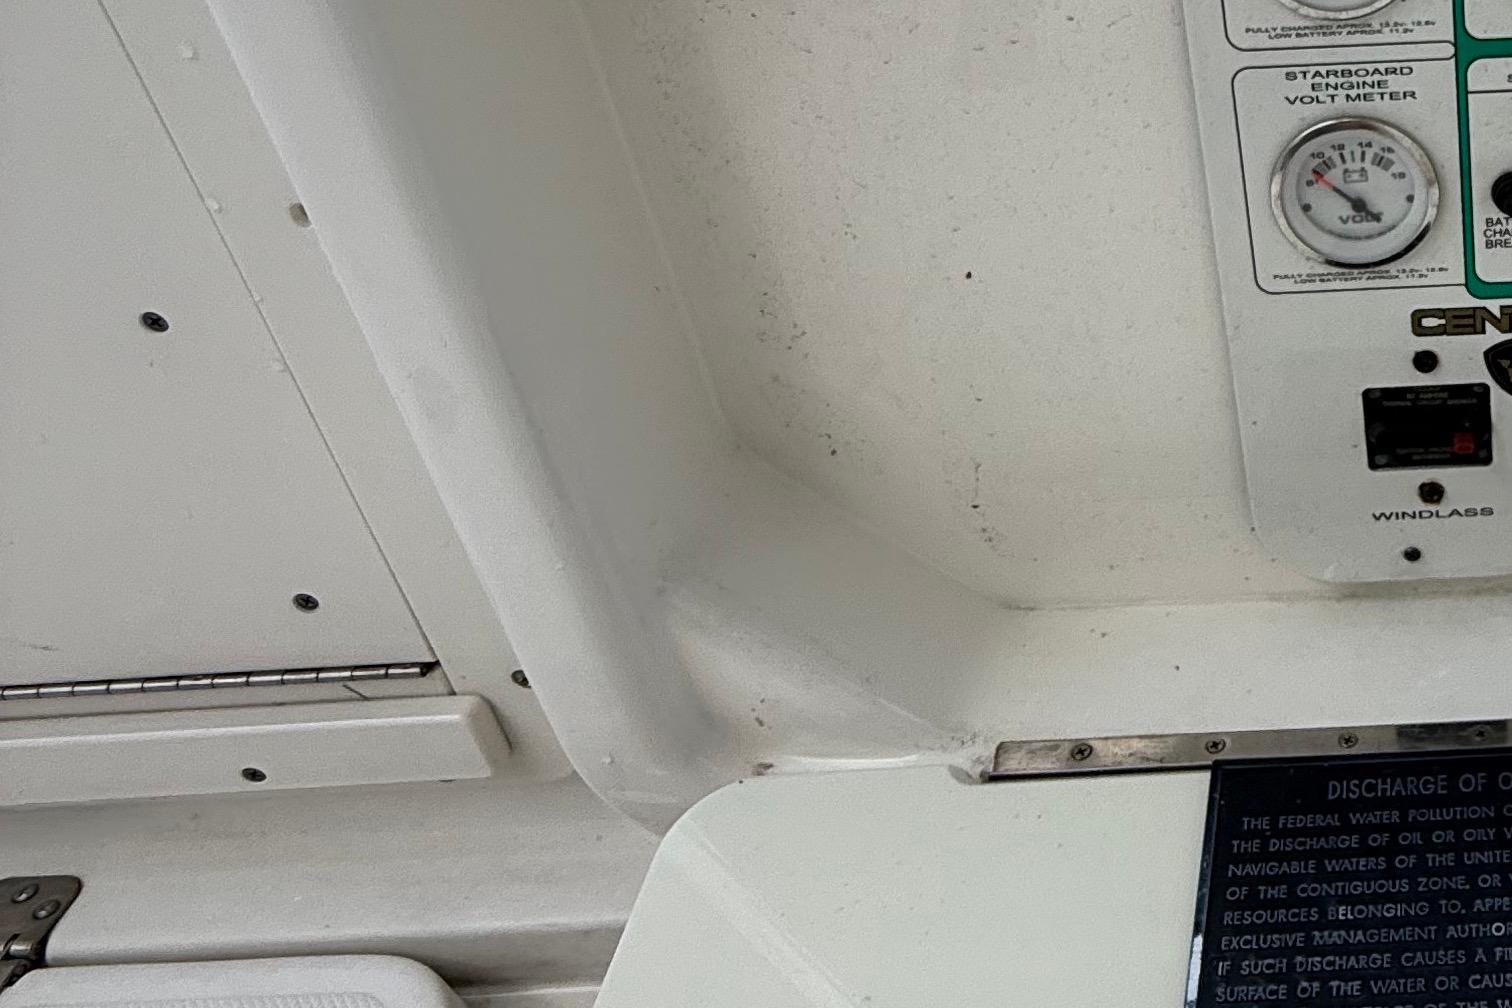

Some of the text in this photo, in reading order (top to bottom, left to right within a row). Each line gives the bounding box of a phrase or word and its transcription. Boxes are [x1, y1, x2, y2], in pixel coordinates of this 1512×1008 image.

[1285, 66, 1413, 81] STARBOARD
[1284, 90, 1417, 105] VOLT METER
[1311, 80, 1389, 92] ENGINE
[1372, 507, 1495, 522] WINDLASS
[1328, 775, 1448, 800] DISCHARGE
[1459, 773, 1487, 793] OF
[1242, 816, 1270, 830] THE
[1278, 814, 1340, 829] FEDERAL
[1349, 811, 1400, 825] WATER
[1408, 806, 1495, 822] POLLUTION
[1232, 839, 1261, 853] THE
[1269, 835, 1360, 852] DISCHARGE
[1368, 833, 1391, 847] OF
[1399, 832, 1423, 845] OIL
[1432, 830, 1455, 843] OR
[1464, 828, 1496, 842] OILY
[1218, 961, 1232, 976] IF
[1240, 959, 1287, 975] SUCH
[1296, 953, 1392, 972] DISCHARGE
[1401, 950, 1466, 967] CAUSES
[1474, 948, 1487, 962] A
[1216, 984, 1287, 1002] SURFACE
[1297, 982, 1320, 998] OF
[1328, 980, 1362, 996] THE
[1370, 978, 1426, 994] WATER
[1434, 976, 1459, 990] OR
